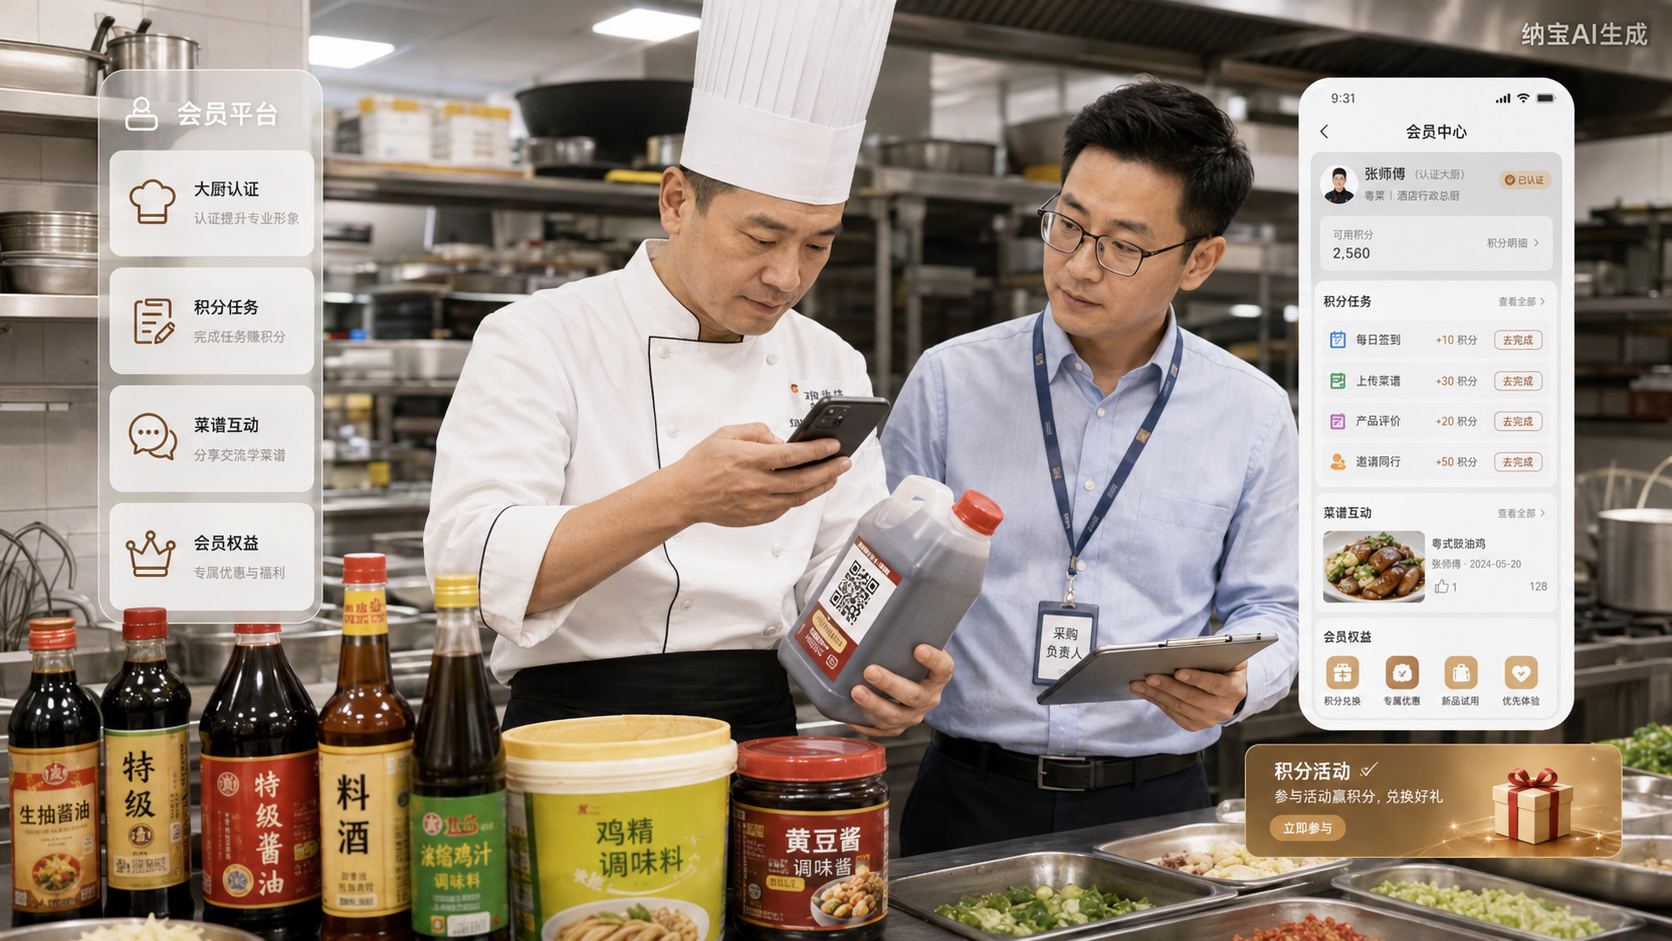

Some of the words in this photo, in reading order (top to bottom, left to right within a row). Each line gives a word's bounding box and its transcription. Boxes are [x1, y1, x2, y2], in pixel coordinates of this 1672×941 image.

[1053, 626, 1078, 641] 采购
[1046, 644, 1082, 660] 负责人
[122, 750, 156, 818] 特级
[20, 799, 90, 825] 生抽酱油
[336, 774, 370, 855] 料酒
[254, 770, 285, 897] 特级酱油
[596, 817, 654, 846] 鸡精
[785, 826, 861, 854] 黄豆酱
[599, 845, 684, 878] 调味料
[793, 857, 852, 878] 调味酱
[434, 871, 481, 891] 调味料
